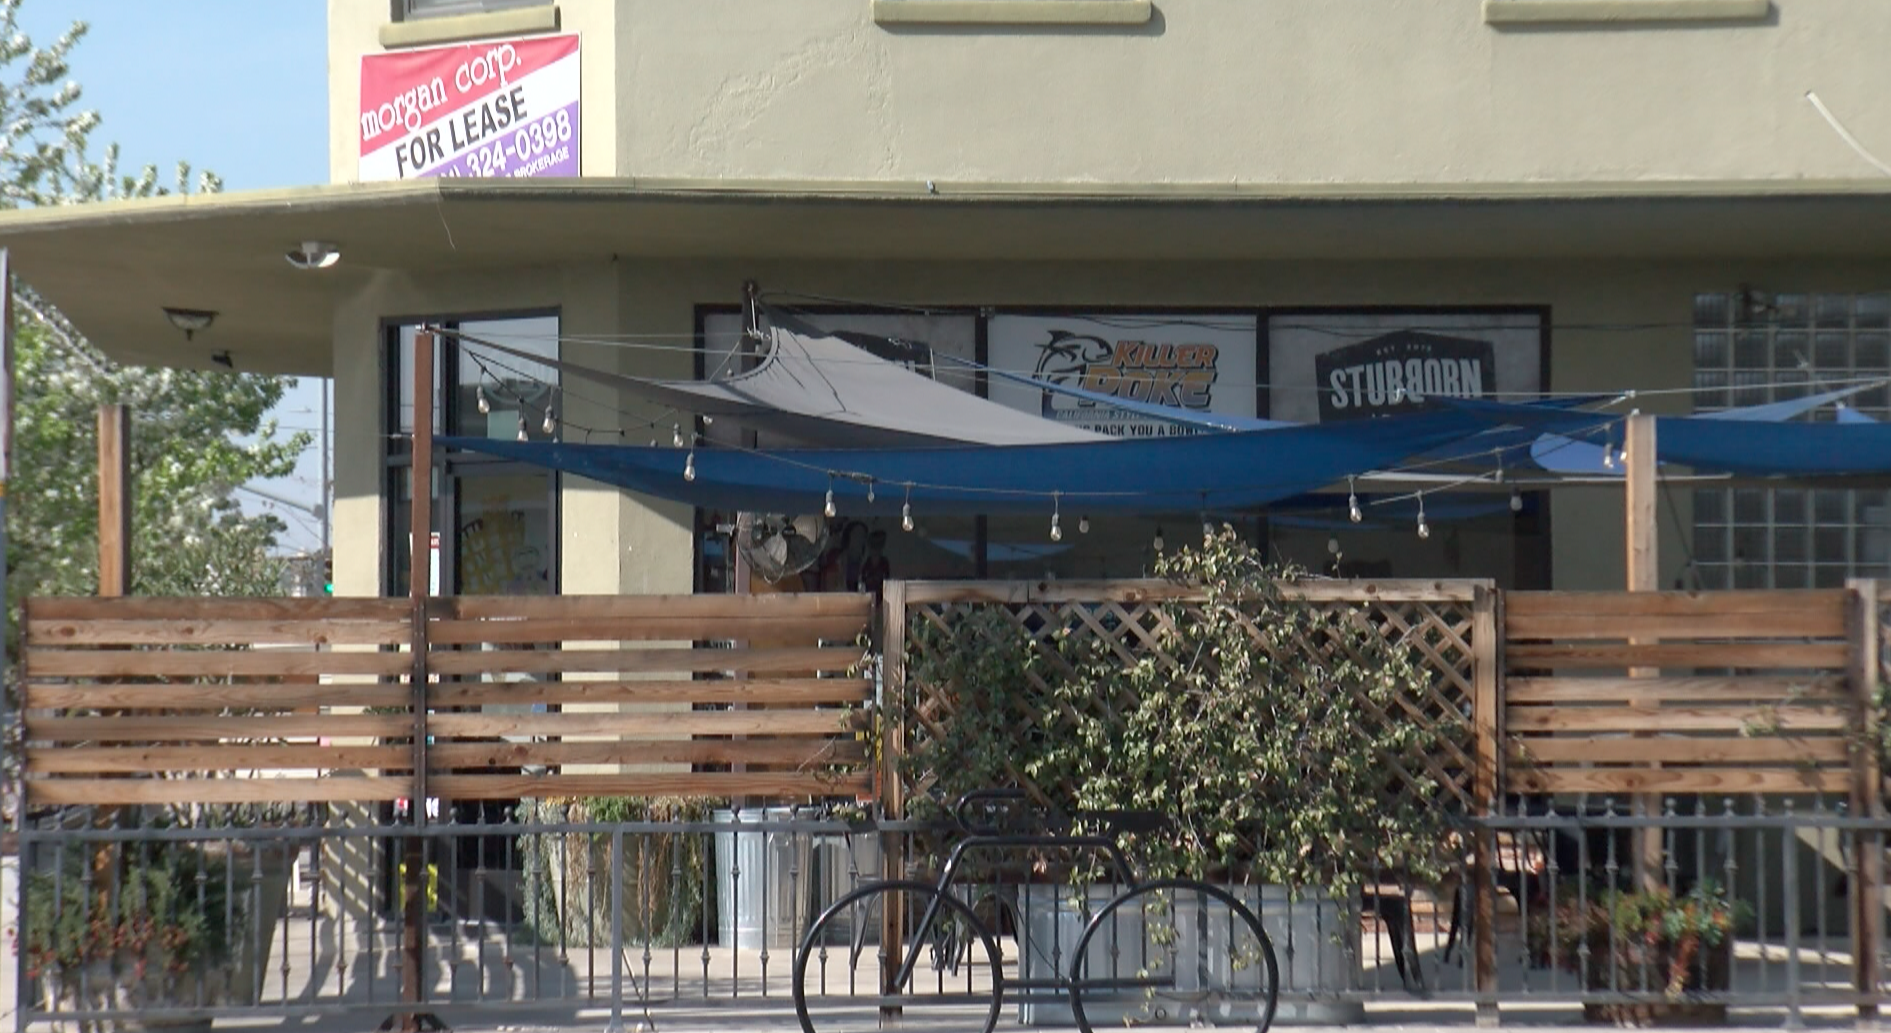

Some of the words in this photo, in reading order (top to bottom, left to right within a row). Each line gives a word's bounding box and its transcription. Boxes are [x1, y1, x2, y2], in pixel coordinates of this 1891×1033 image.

[361, 77, 448, 141] morgan
[455, 44, 522, 88] corp.
[395, 127, 445, 178] FOR
[449, 85, 528, 152] LEASE
[466, 109, 572, 177] 324-0398
[513, 146, 570, 178] BROKERAGE
[1111, 340, 1219, 370] KILLER
[1078, 364, 1218, 408] POKE
[1330, 358, 1483, 409] STUBBORN
[1094, 424, 1125, 436] PACK
[1129, 424, 1153, 436] YOU
[1157, 424, 1165, 435] A
